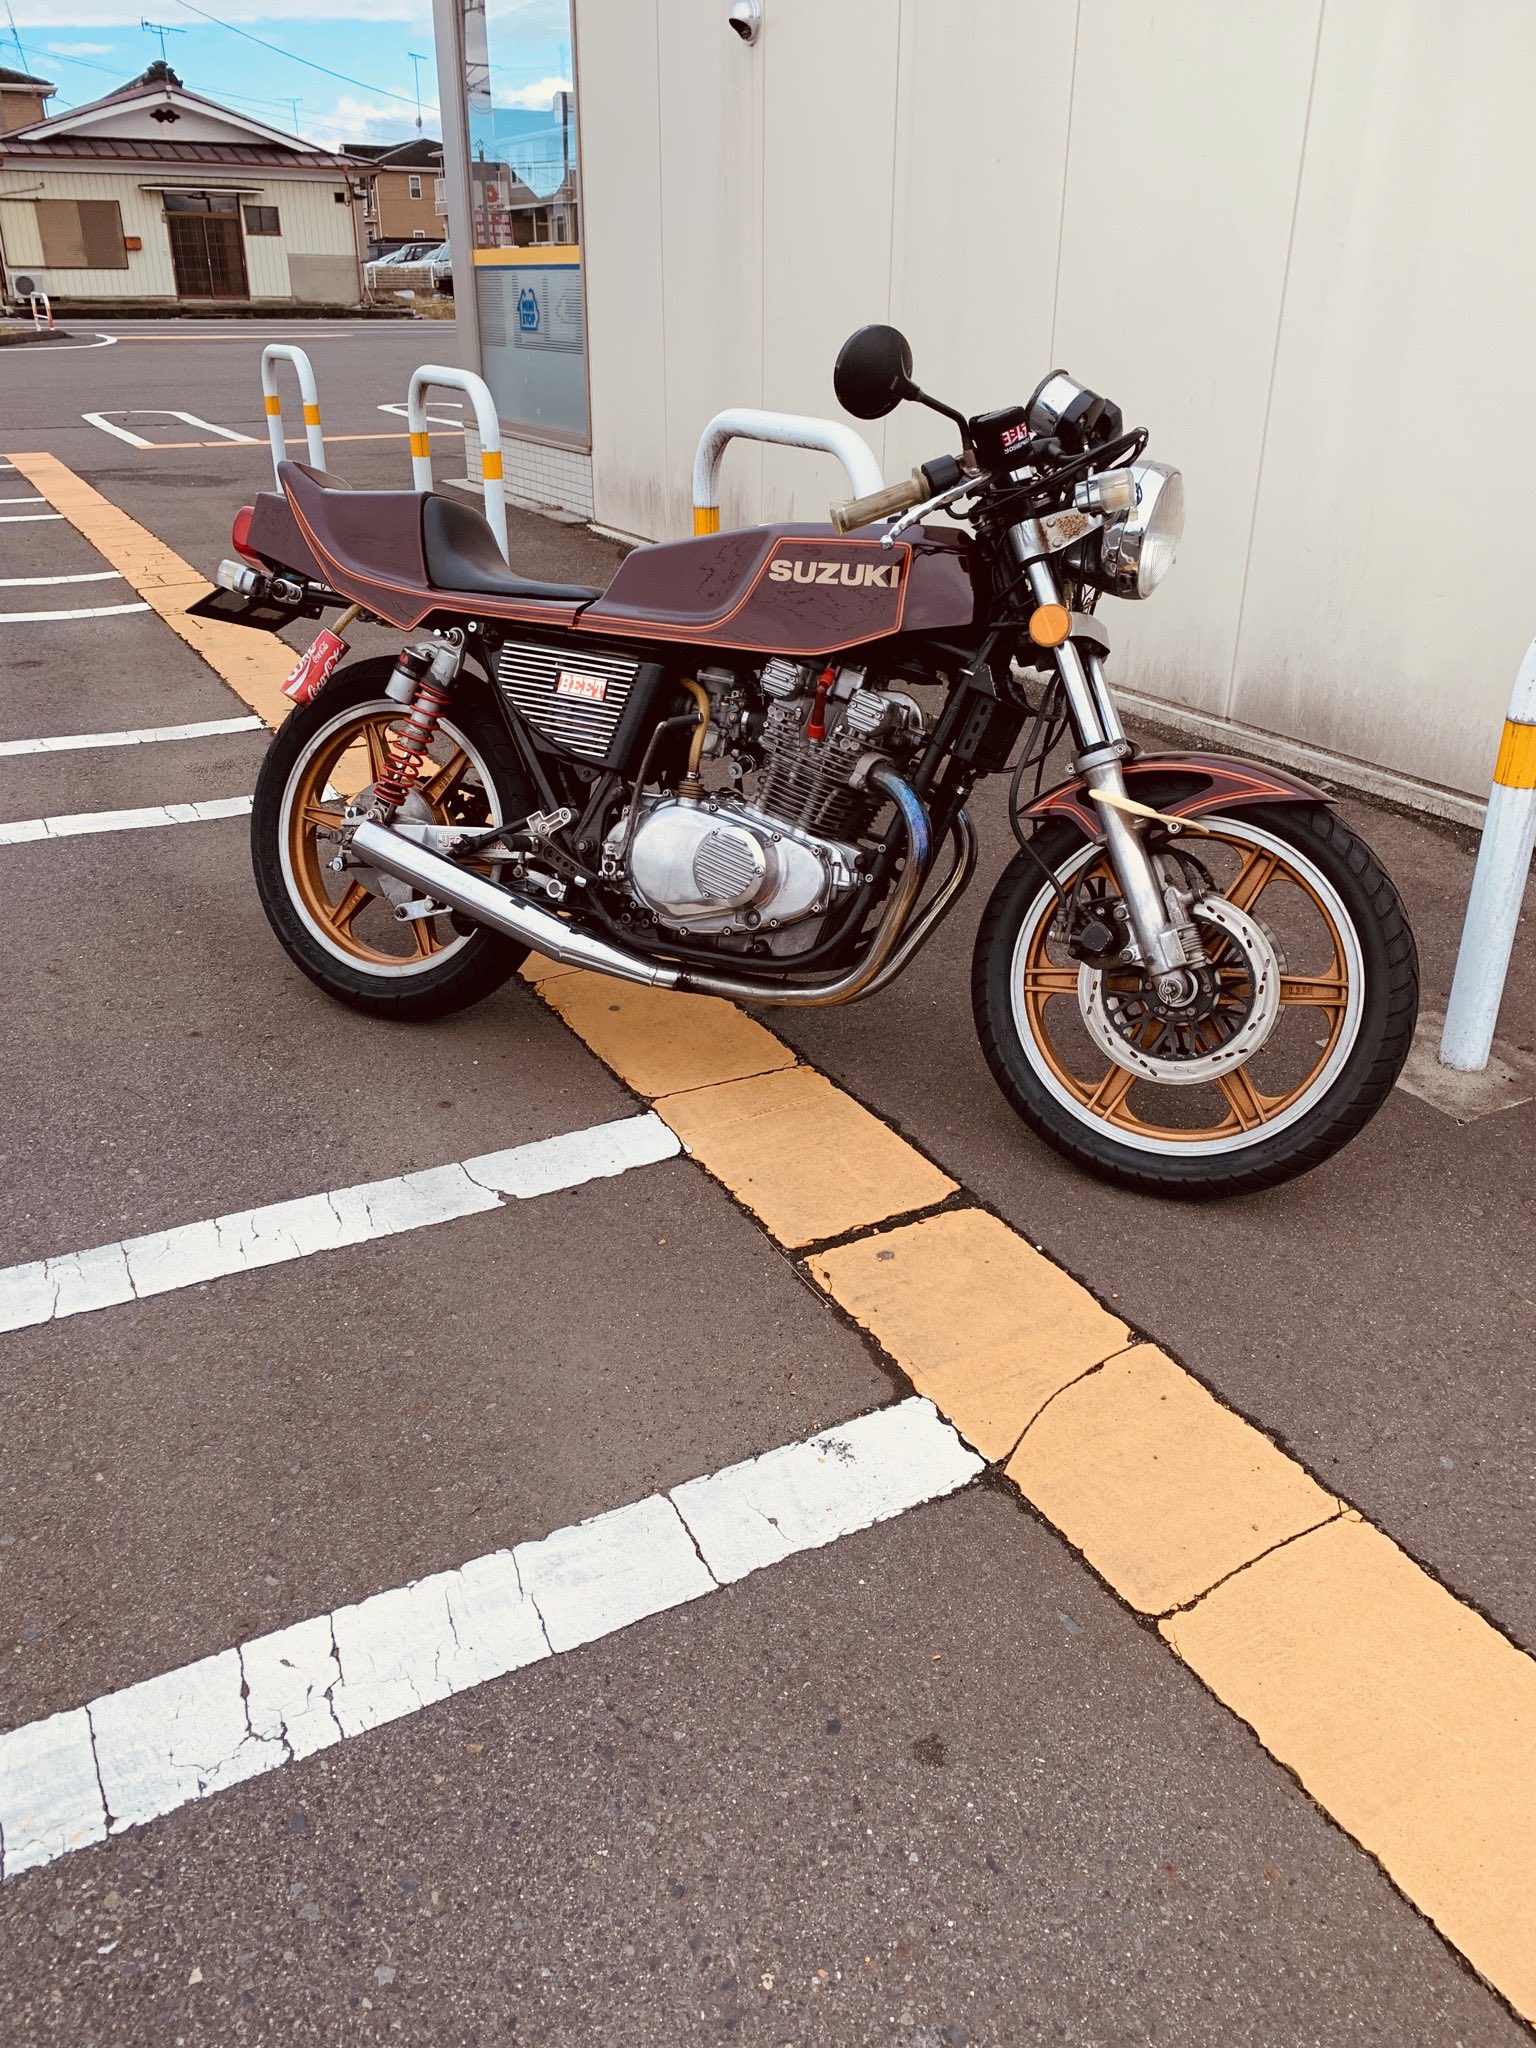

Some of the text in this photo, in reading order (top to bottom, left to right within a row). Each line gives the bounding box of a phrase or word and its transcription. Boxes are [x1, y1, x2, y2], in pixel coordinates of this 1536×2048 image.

[1001, 422, 1028, 447] ヨシムラ
[768, 559, 901, 589] SUZUKI
[560, 672, 606, 700] BEET
